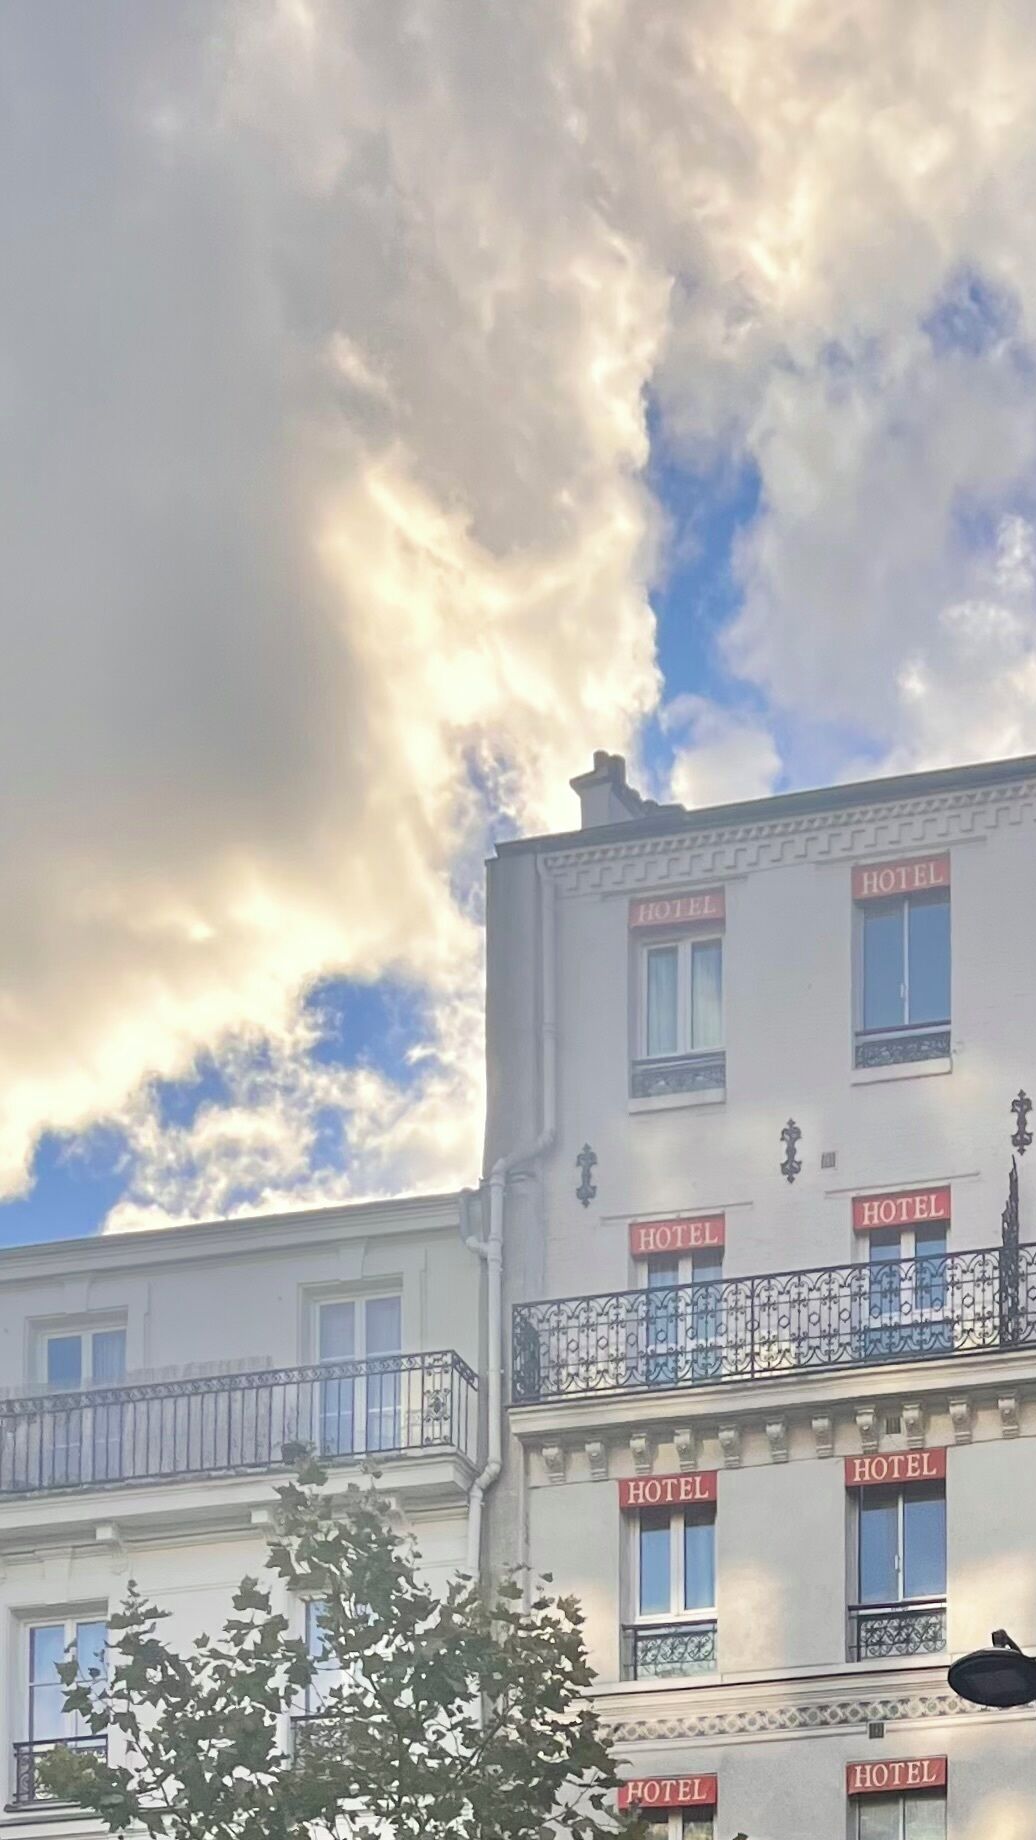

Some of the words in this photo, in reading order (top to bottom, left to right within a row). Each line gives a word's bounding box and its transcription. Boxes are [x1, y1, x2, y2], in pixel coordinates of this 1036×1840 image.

[862, 861, 943, 894] HOTEL
[638, 895, 716, 922] HOTEL
[862, 1194, 945, 1225] HOTEL
[639, 1222, 719, 1251] HOTEL
[853, 1453, 936, 1482] HOTEL
[627, 1477, 709, 1504] HOTEL
[854, 1760, 936, 1789] HOTEL
[627, 1779, 706, 1804] HOTEL
